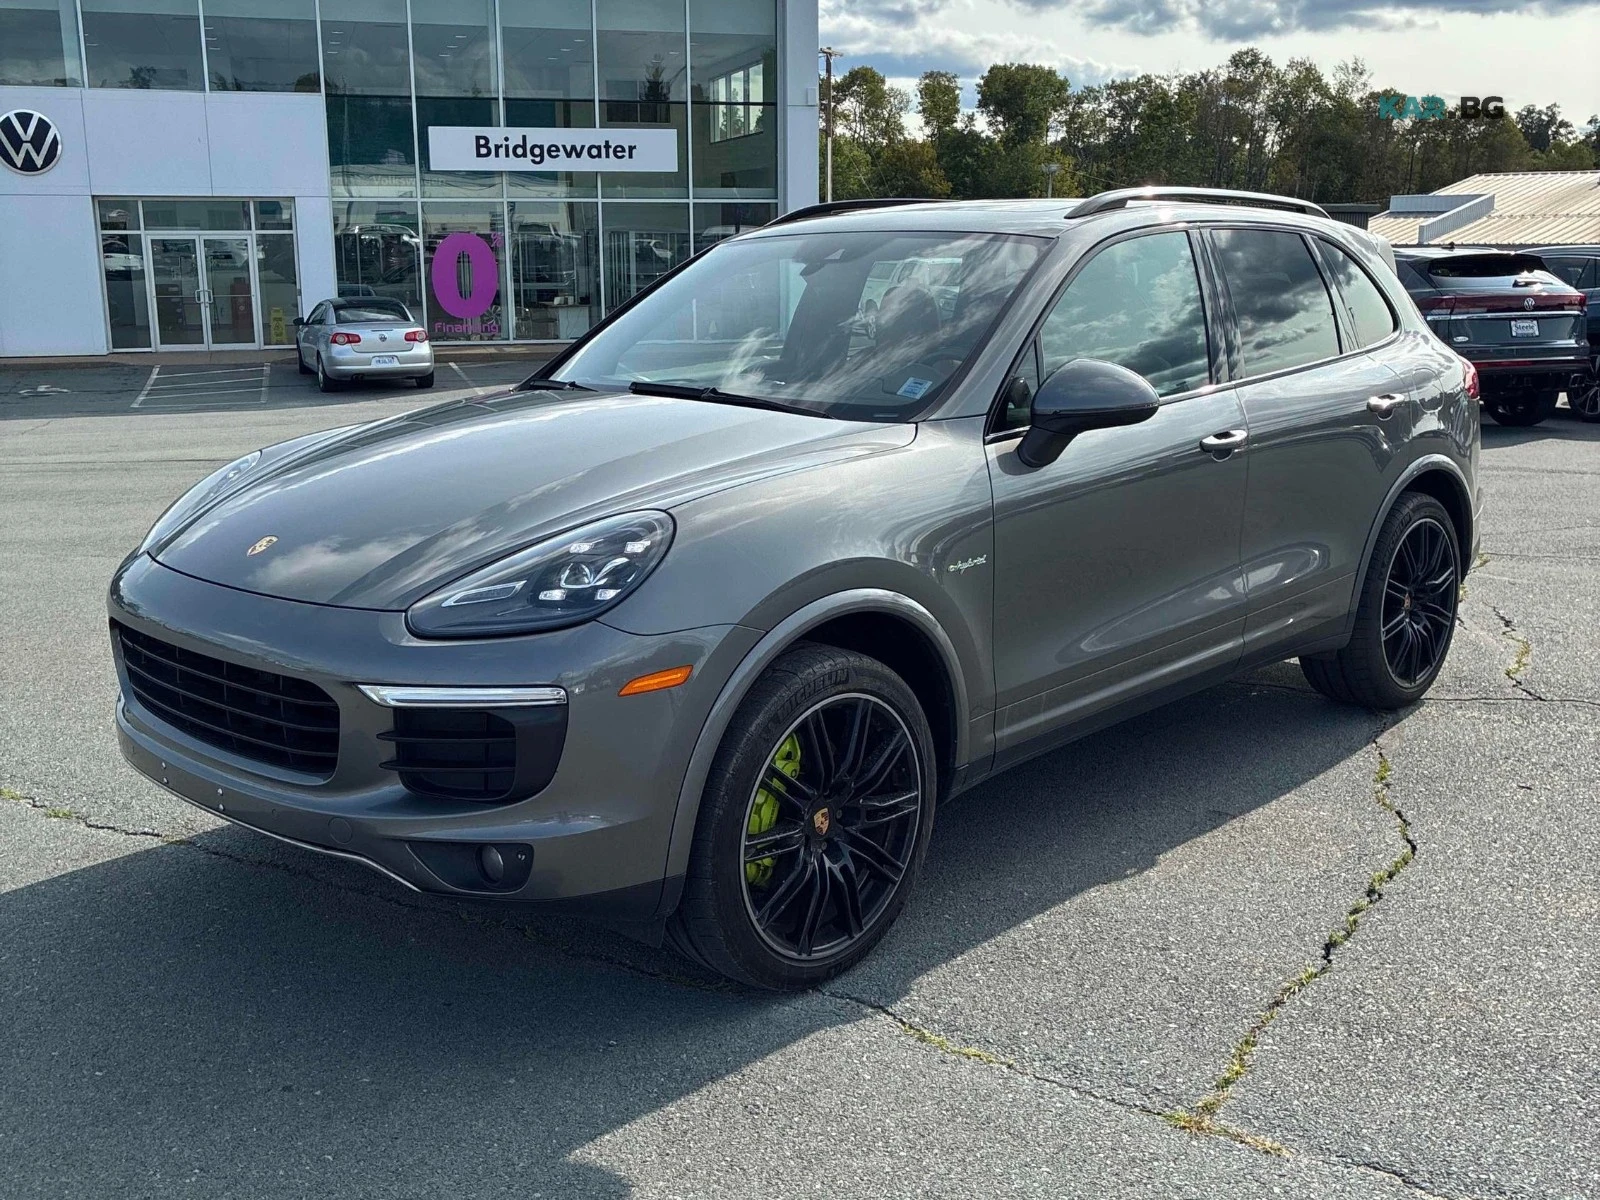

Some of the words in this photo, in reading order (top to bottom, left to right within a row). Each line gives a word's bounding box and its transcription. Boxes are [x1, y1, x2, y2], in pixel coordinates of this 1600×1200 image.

[475, 135, 637, 165] Bridgewater
[372, 175, 446, 187] Volkswgen
[434, 322, 499, 336] Finanng
[1515, 323, 1535, 331] Steele
